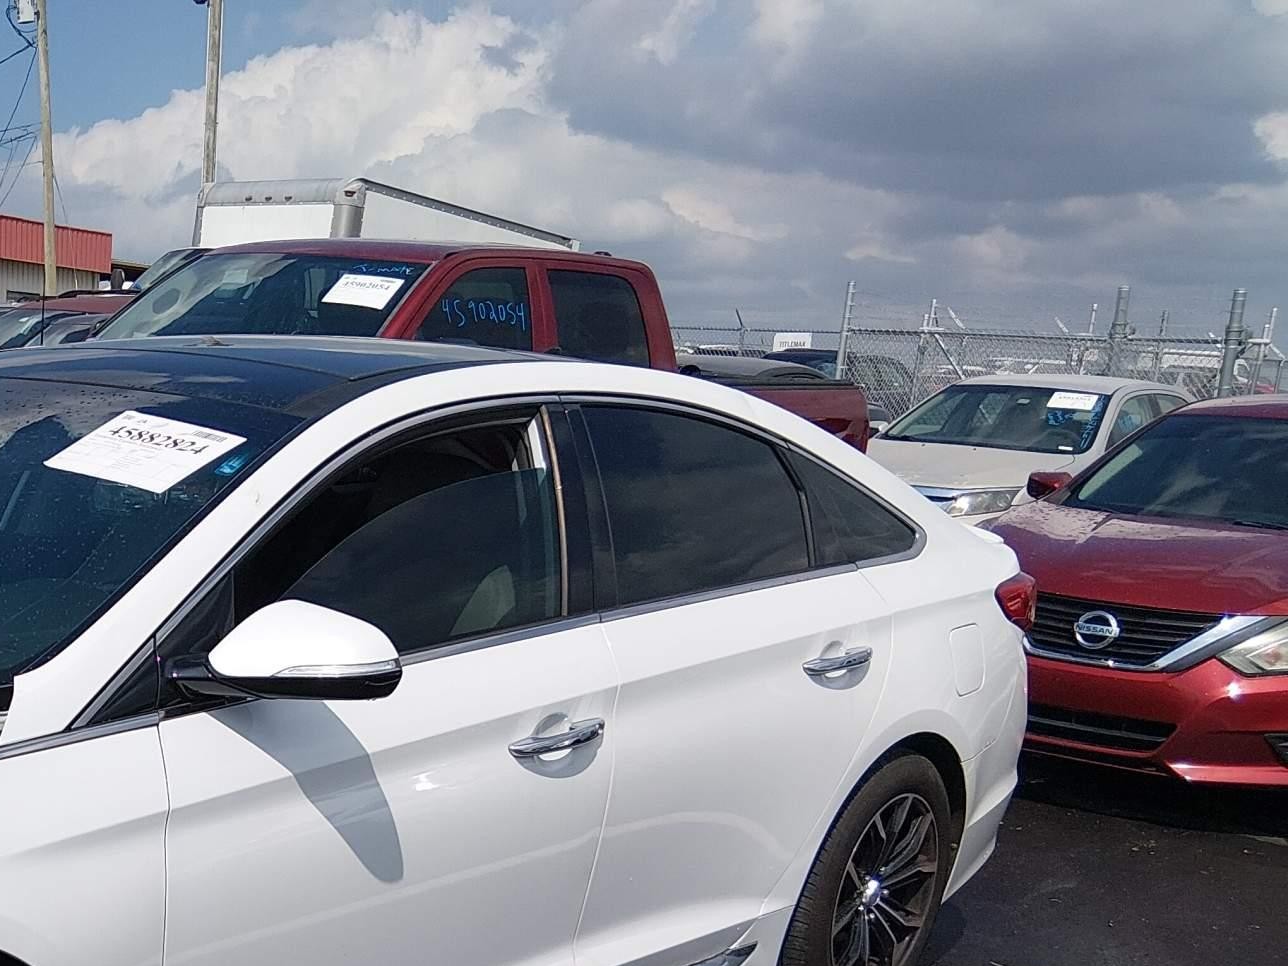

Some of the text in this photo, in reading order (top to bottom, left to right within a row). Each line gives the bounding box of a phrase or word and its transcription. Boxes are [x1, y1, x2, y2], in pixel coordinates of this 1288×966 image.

[442, 299, 526, 331] 45902054
[109, 426, 209, 455] 45882824
[1076, 623, 1113, 635] NISSAN
